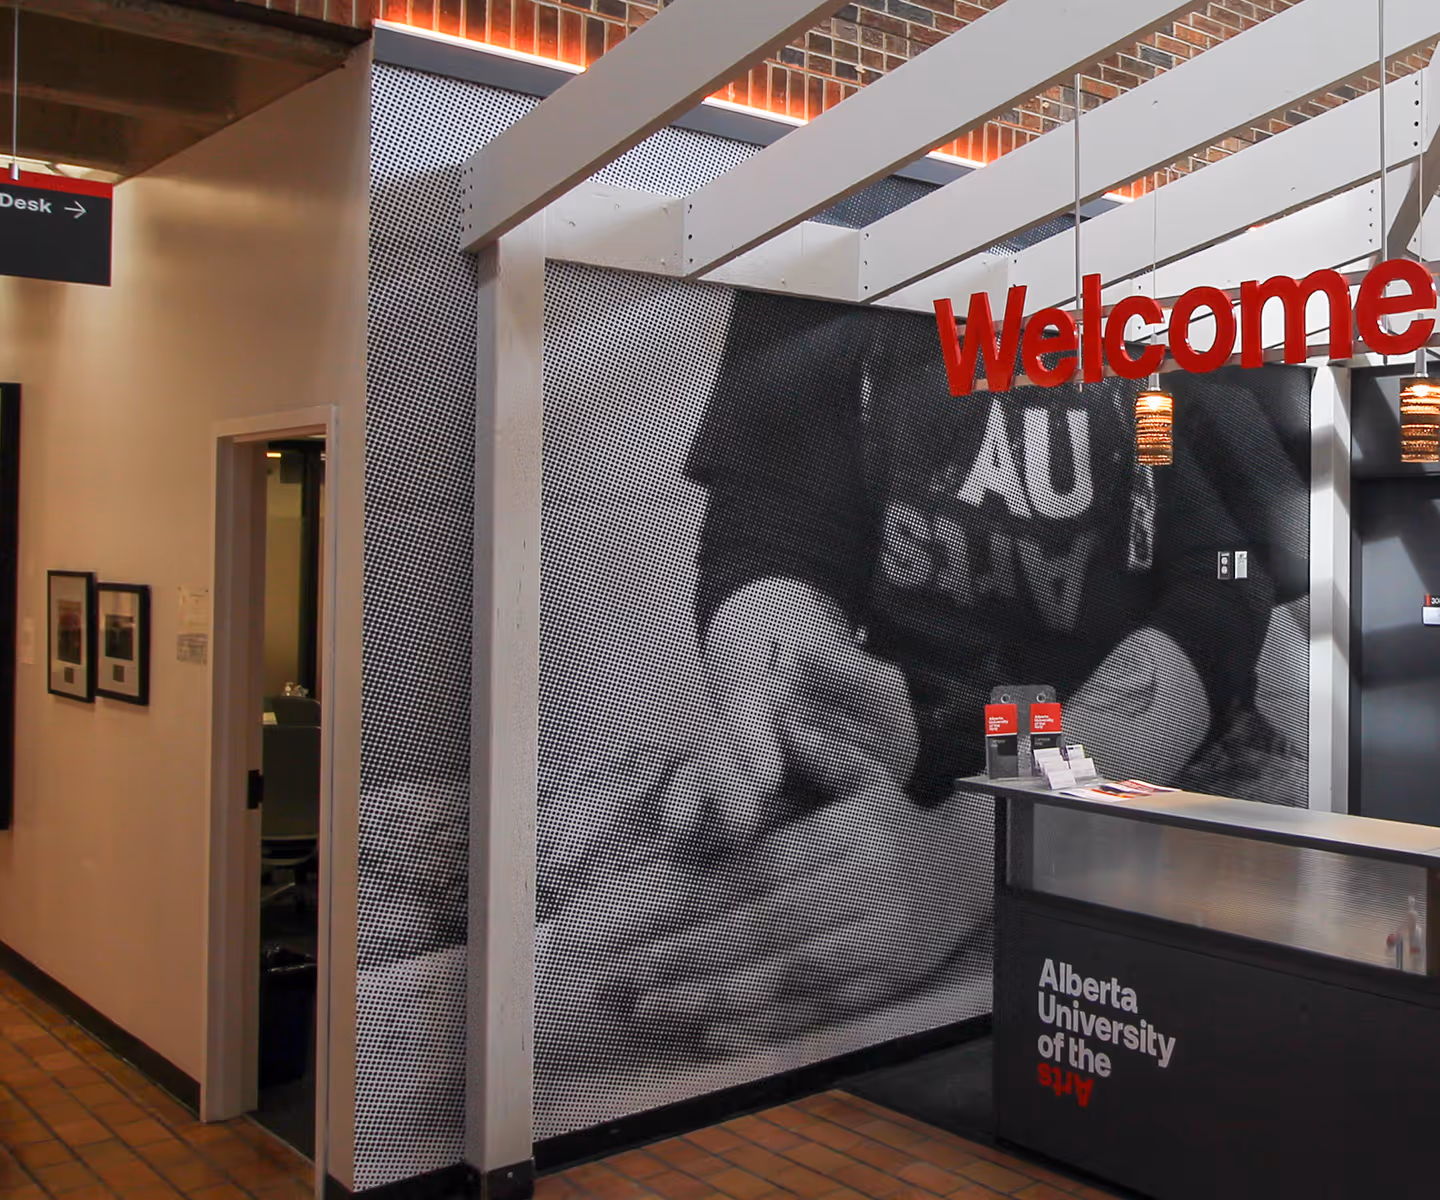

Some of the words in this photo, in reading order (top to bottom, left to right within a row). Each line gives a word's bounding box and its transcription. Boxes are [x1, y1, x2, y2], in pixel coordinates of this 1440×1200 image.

[0, 193, 52, 214] Desk
[933, 258, 1438, 397] Welcome
[956, 398, 1094, 520] AU
[1038, 958, 1138, 1014] Alberta
[1037, 1032, 1065, 1062] of
[1068, 1037, 1112, 1078] the
[1038, 990, 1176, 1069] University
[1037, 1062, 1095, 1108] Arts
